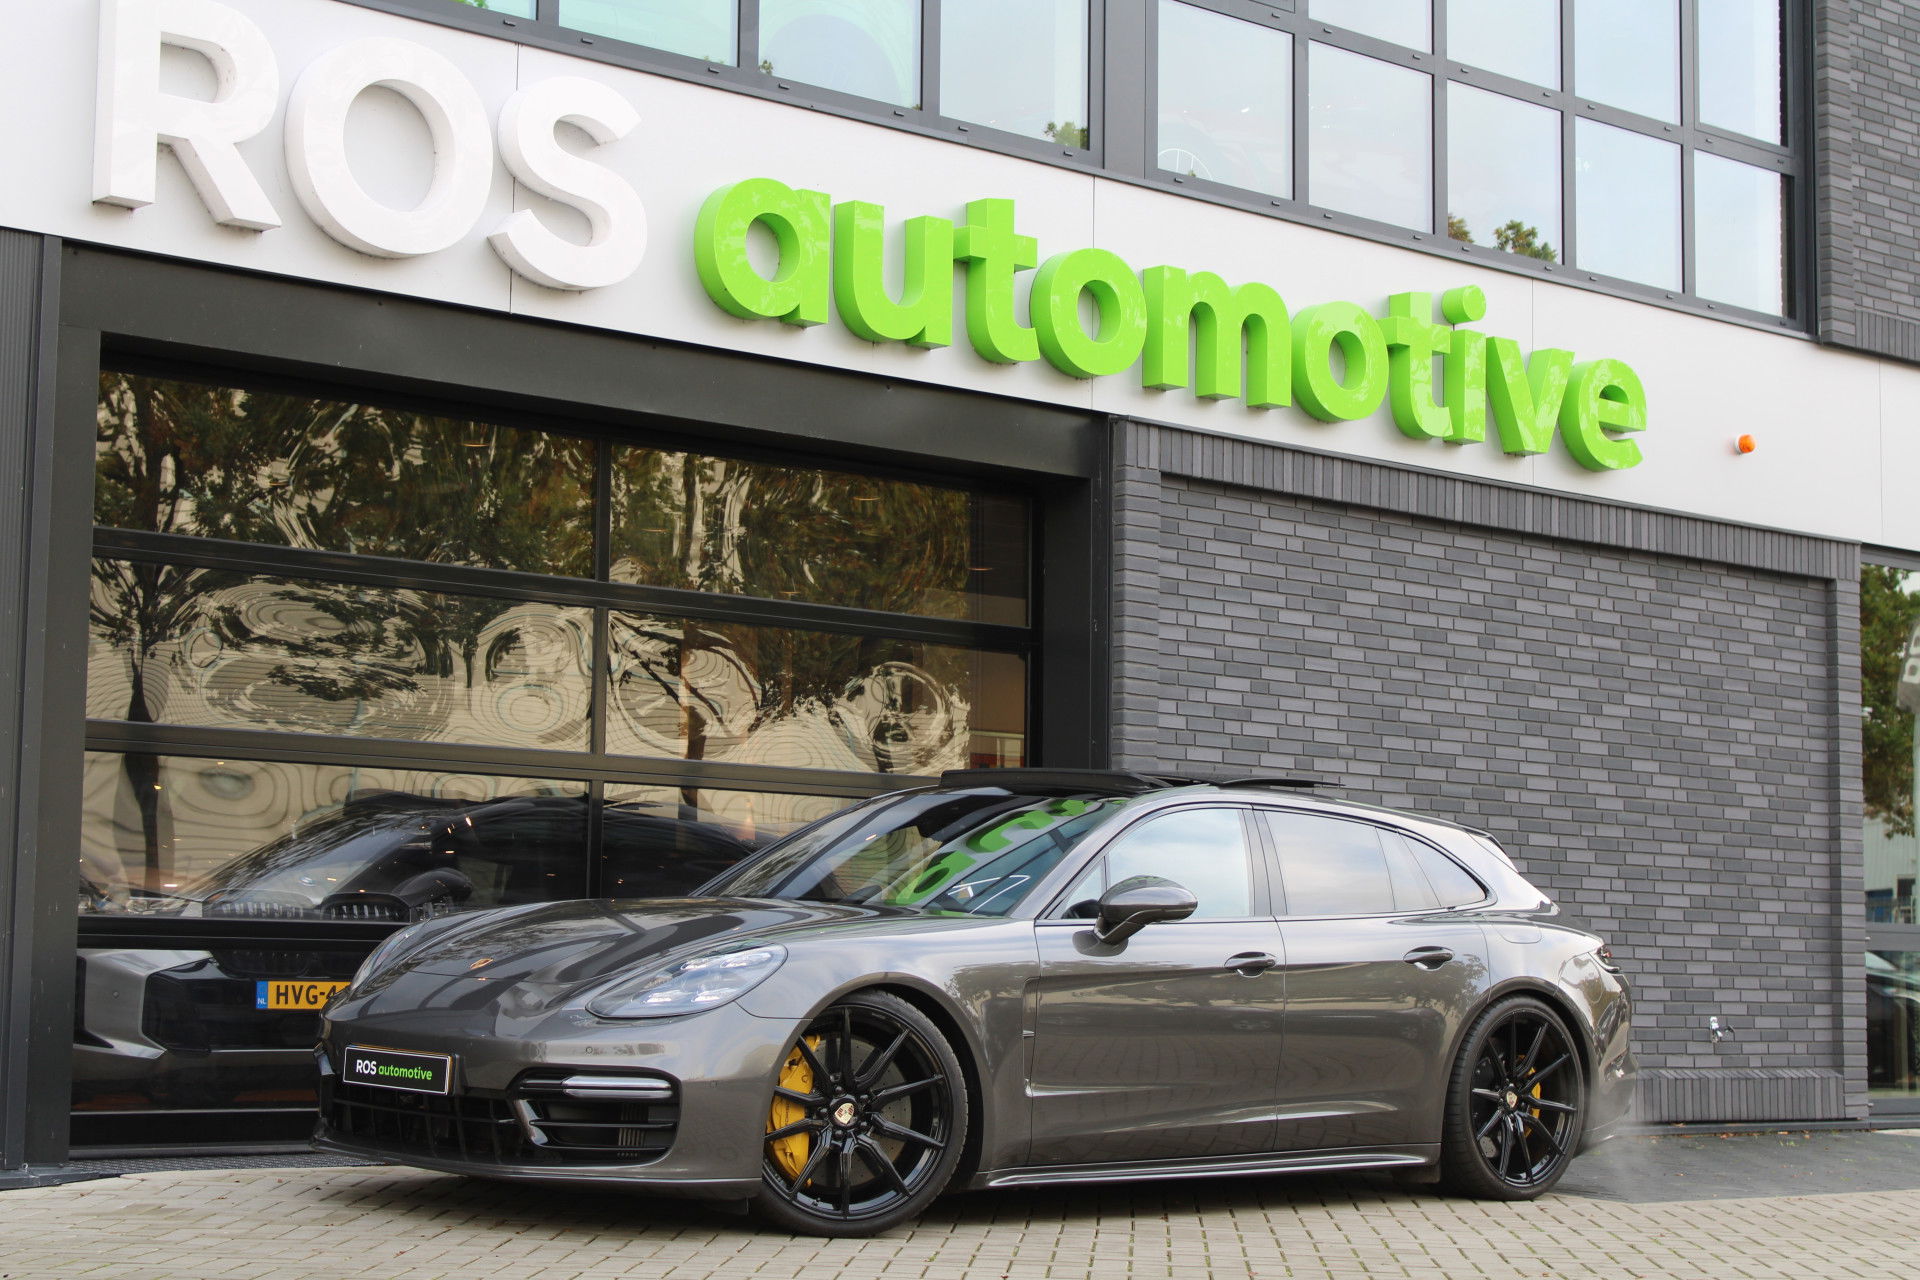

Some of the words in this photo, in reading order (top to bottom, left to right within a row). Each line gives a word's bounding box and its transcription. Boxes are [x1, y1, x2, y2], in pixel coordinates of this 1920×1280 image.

[93, 0, 648, 291] ROS
[694, 178, 1647, 471] automotive
[356, 1059, 377, 1075] ROS
[378, 1064, 432, 1080] automotive
